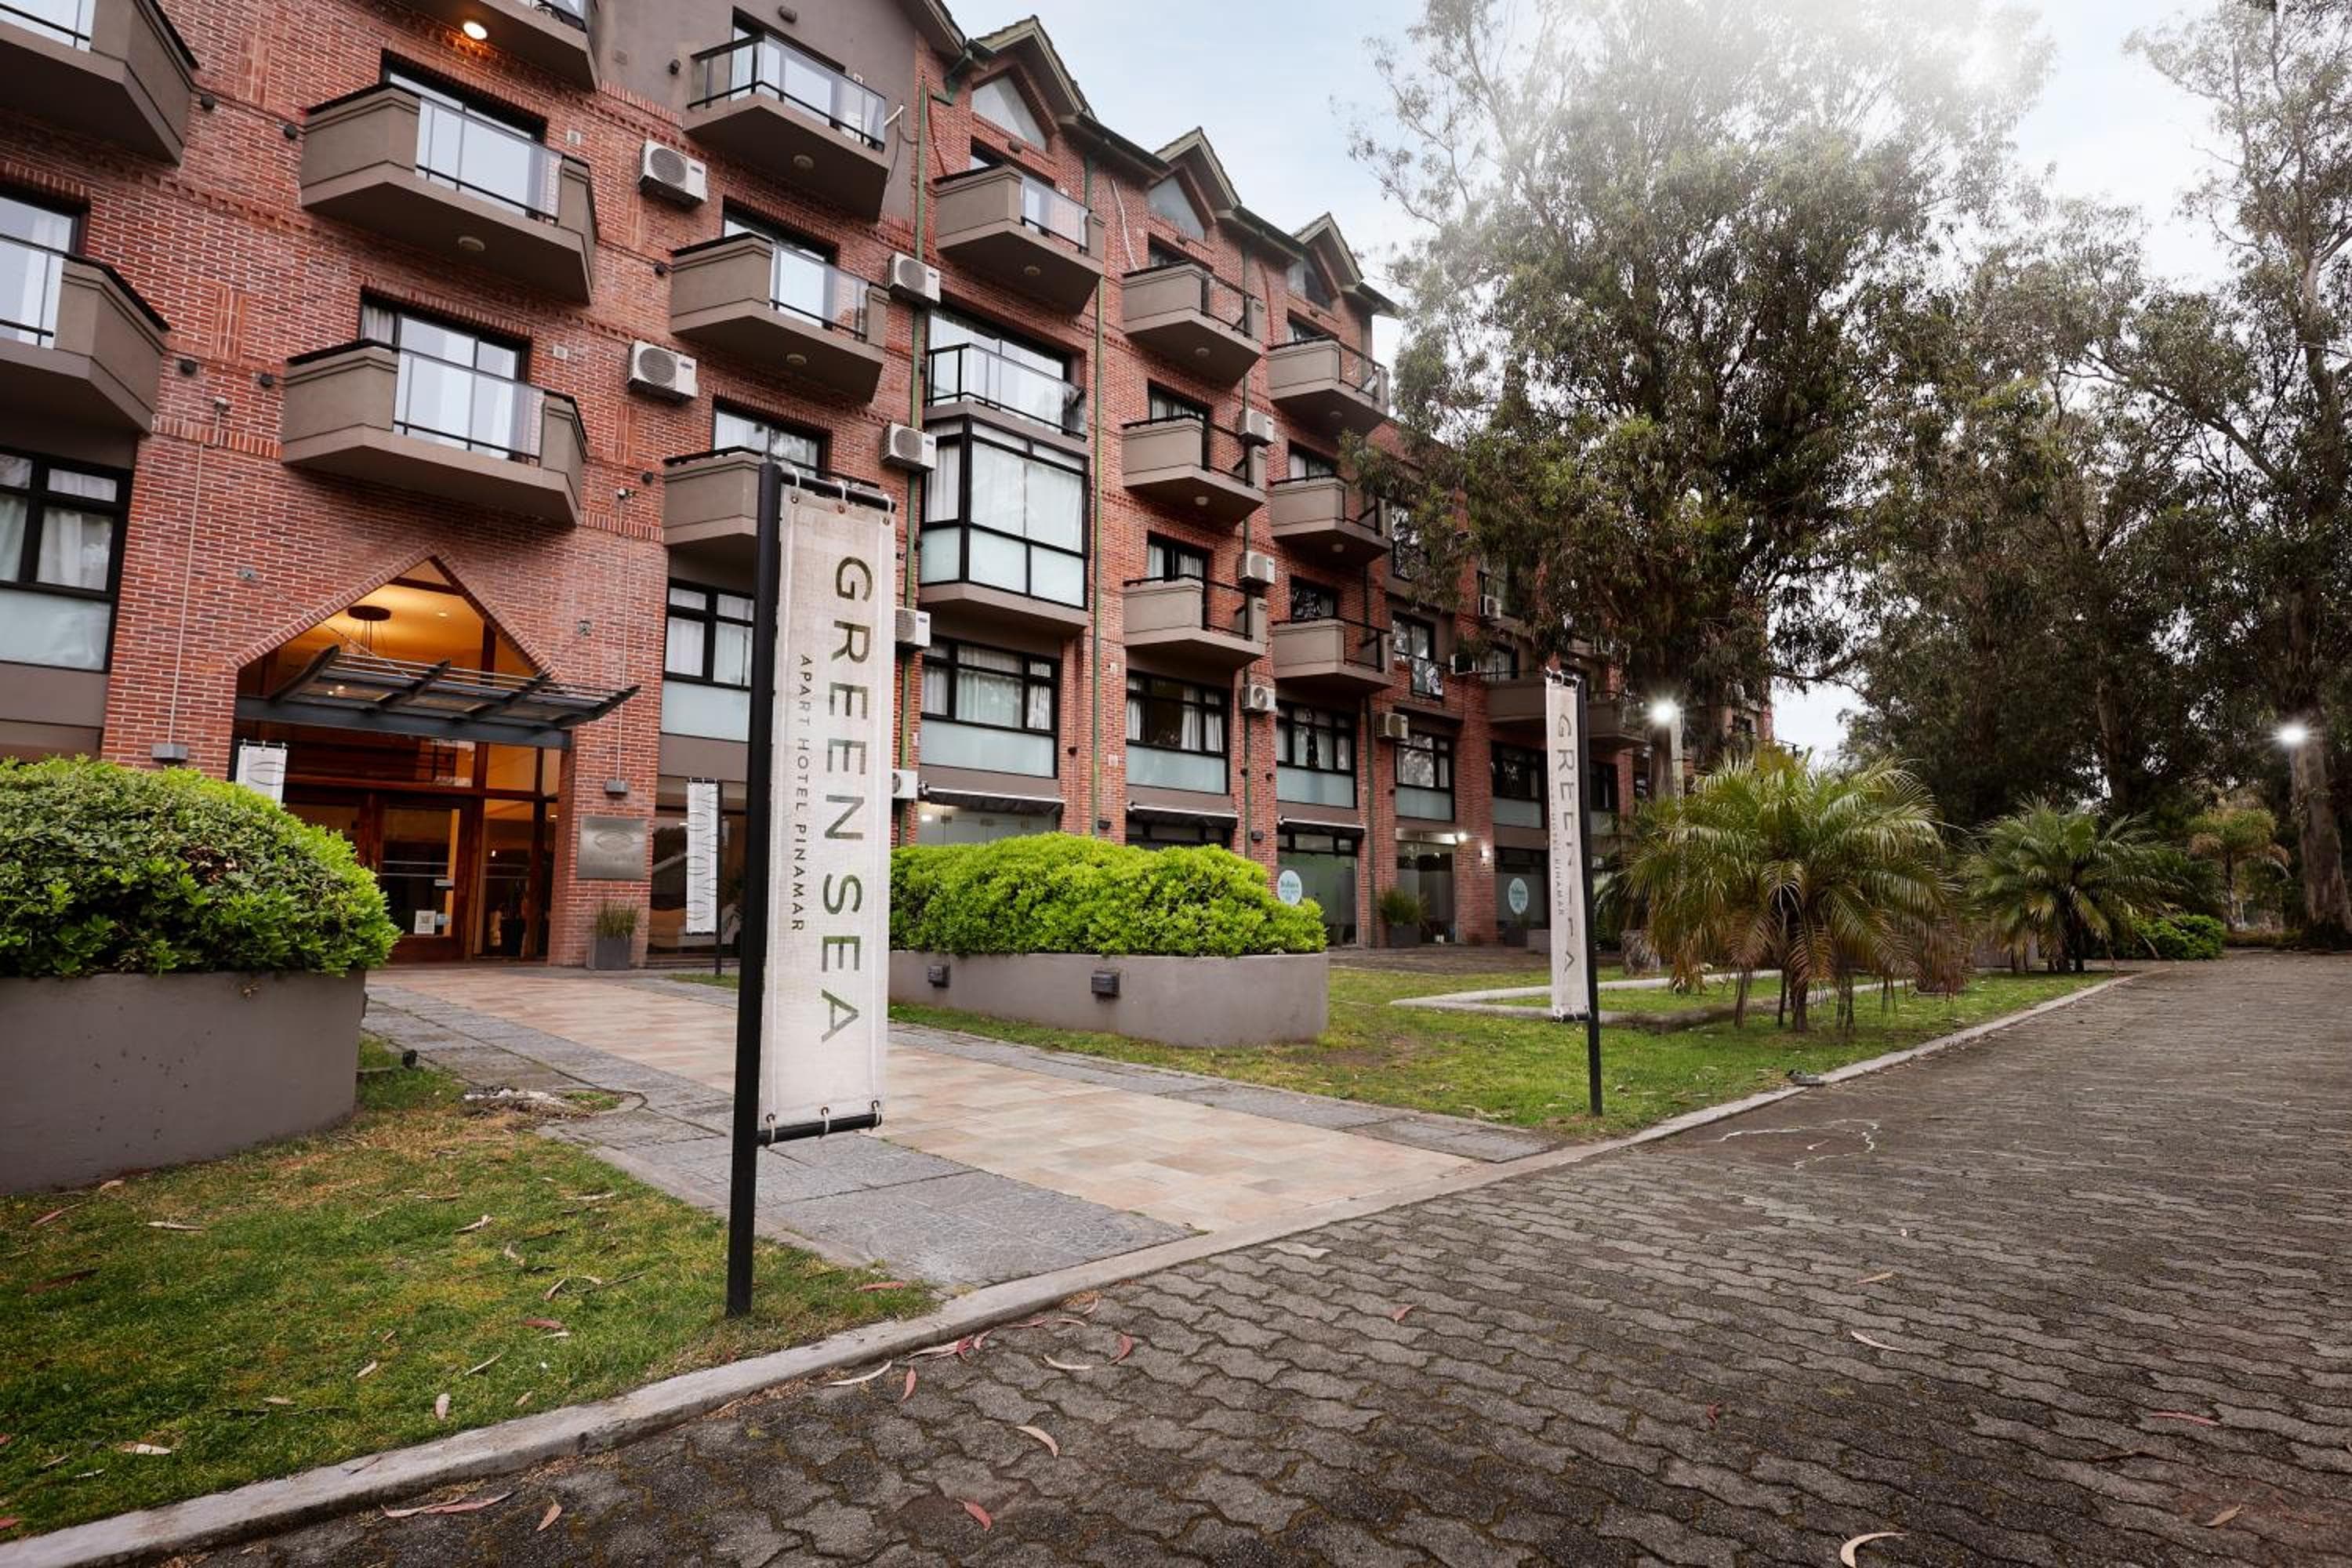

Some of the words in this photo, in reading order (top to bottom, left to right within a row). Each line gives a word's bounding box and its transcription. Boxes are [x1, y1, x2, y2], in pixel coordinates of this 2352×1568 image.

[798, 653, 814, 727] APART
[824, 556, 873, 841] GREEN
[795, 738, 810, 811] HOTEL
[790, 823, 808, 931] PINAMAR
[821, 873, 863, 1043] SEA
